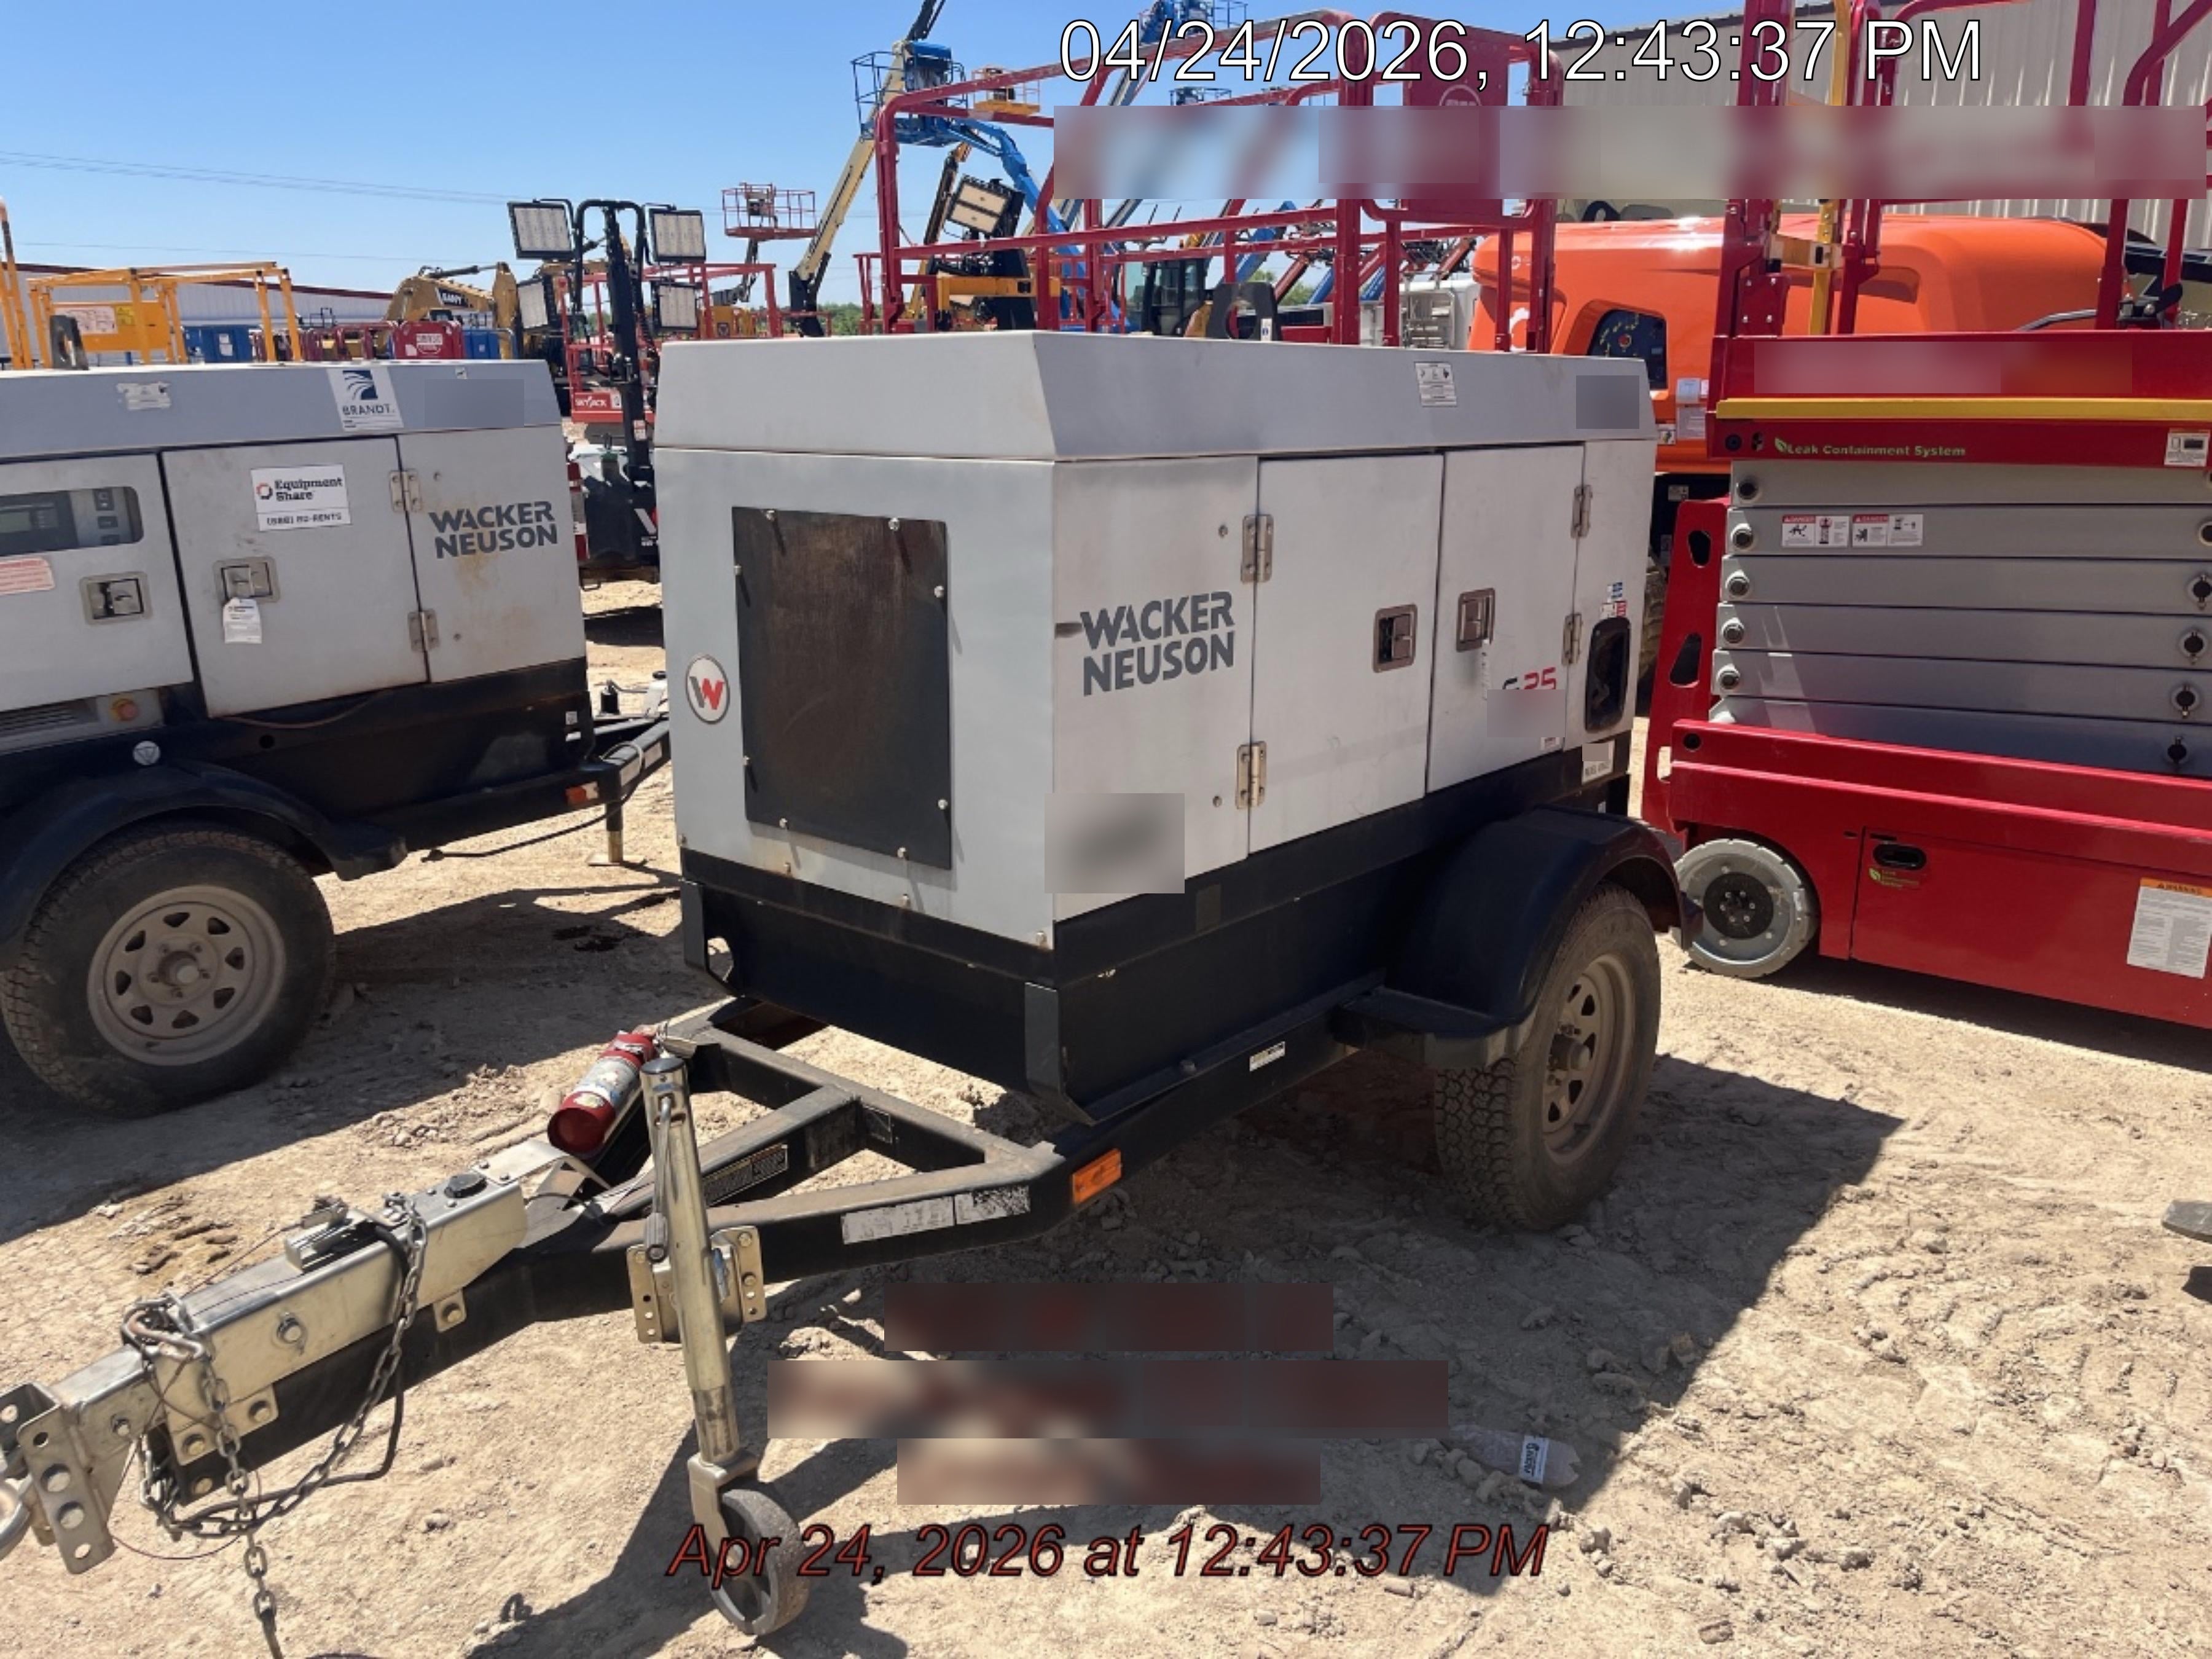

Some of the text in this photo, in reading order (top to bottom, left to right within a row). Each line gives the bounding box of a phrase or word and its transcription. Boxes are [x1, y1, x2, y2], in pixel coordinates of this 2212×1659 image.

[1788, 445, 1966, 458] Leak Containment System
[275, 477, 343, 490] Equipment
[276, 492, 313, 501] Share
[428, 501, 555, 533] WACKER
[434, 523, 558, 559] NEUSON
[1080, 590, 1236, 650] WACKER
[1083, 630, 1235, 697] NEUSON
